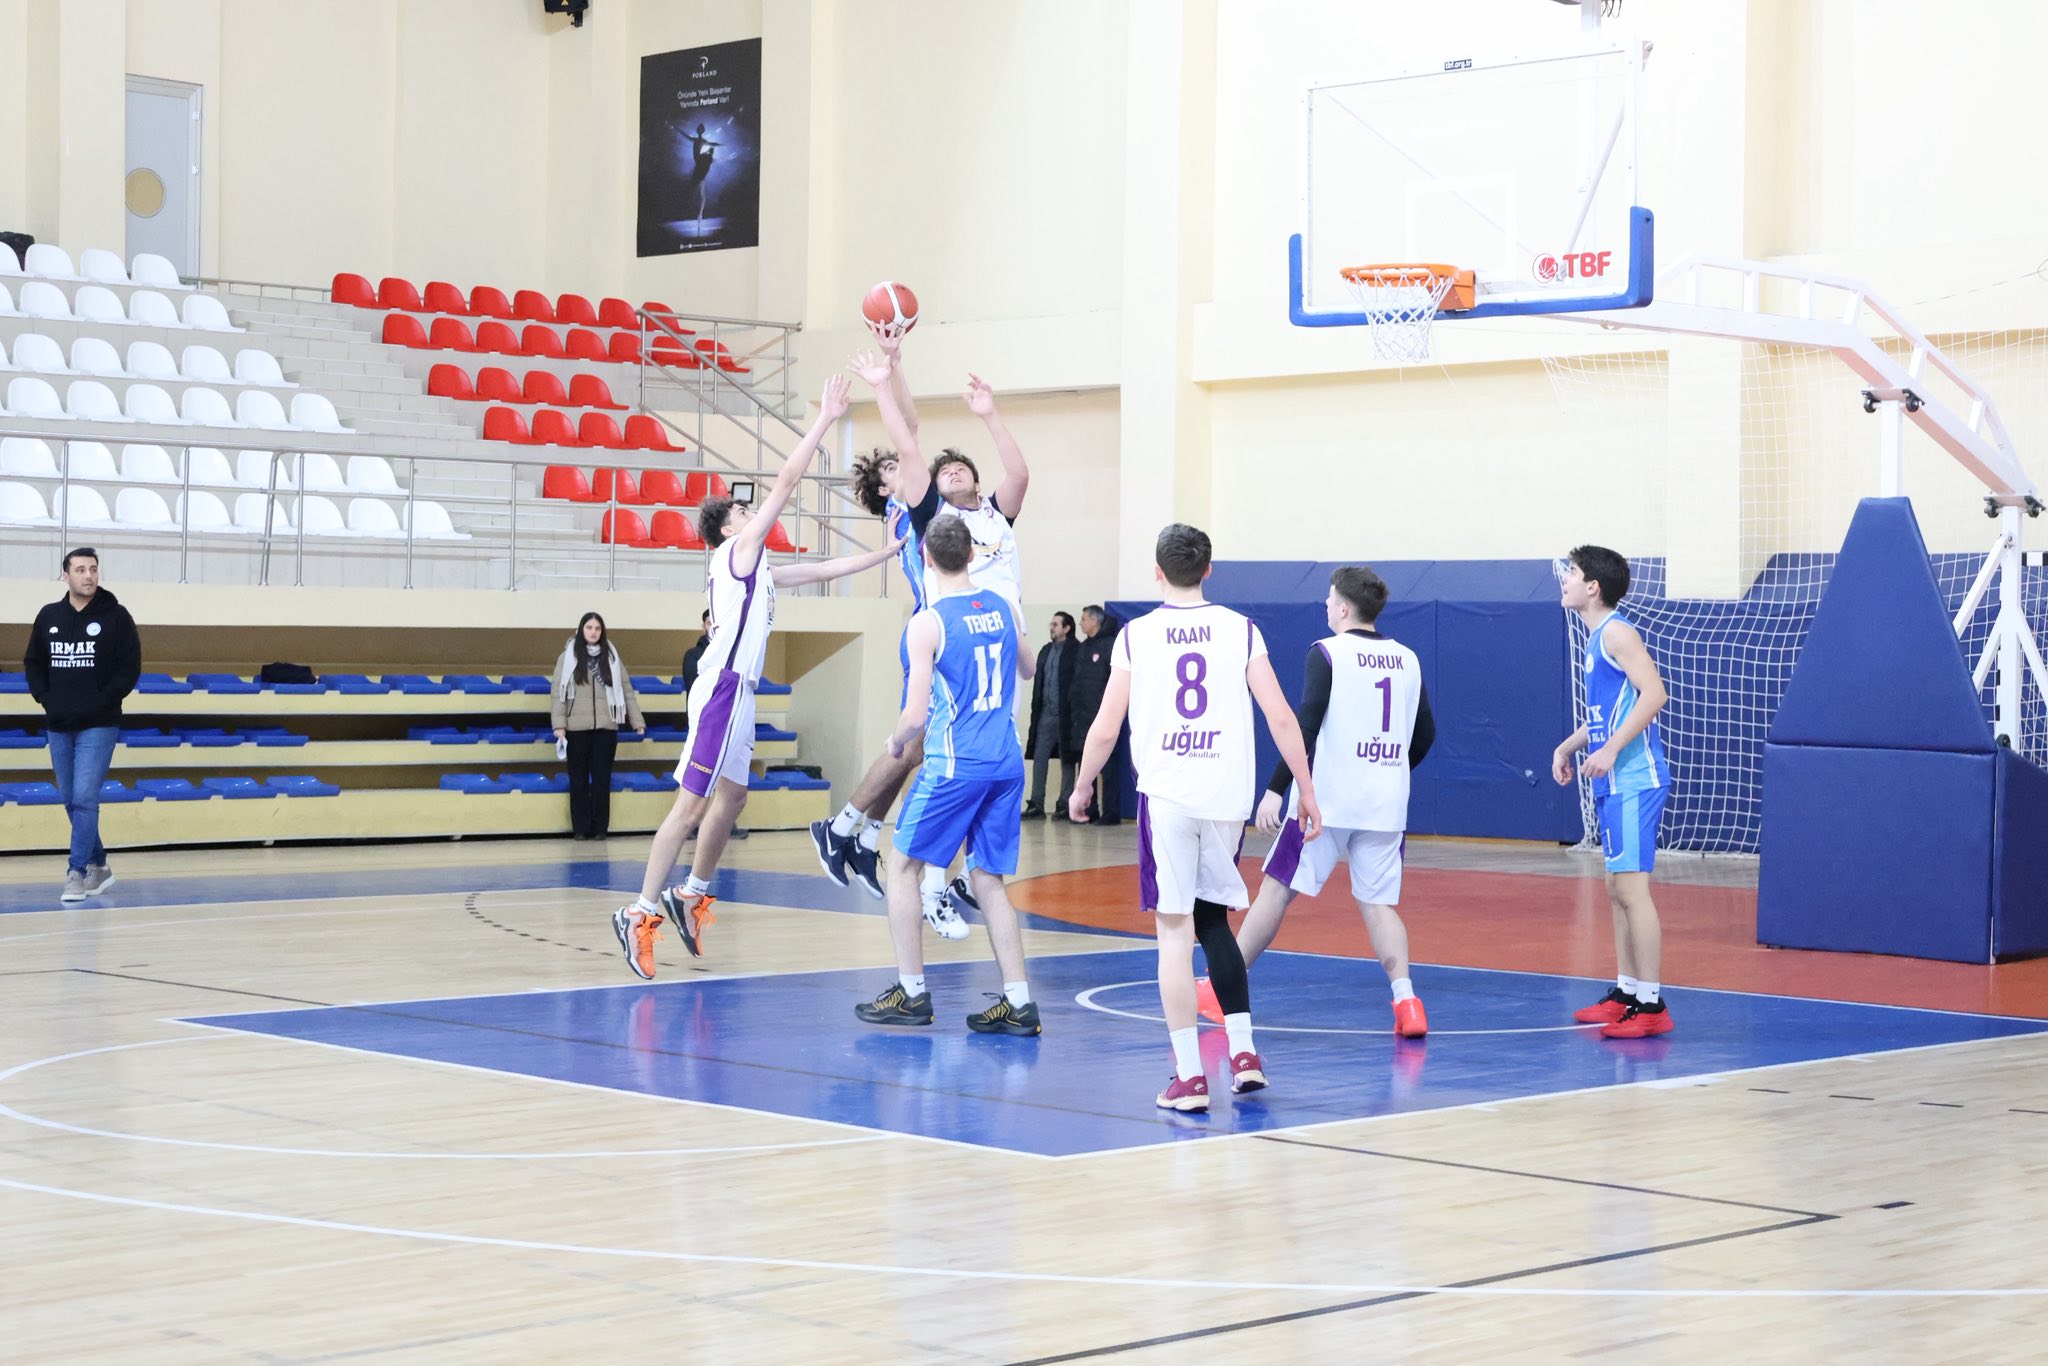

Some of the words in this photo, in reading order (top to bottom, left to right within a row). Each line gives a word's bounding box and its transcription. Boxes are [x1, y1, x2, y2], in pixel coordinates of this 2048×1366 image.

[1563, 251, 1612, 278] TBF
[963, 610, 1005, 635] TEVER
[1166, 625, 1211, 644] KAAN
[50, 641, 96, 654] IRMAK
[1357, 653, 1404, 670] DORUK
[1175, 652, 1208, 719] 8
[1375, 677, 1392, 732] 1
[1161, 724, 1222, 756] uğur
[1356, 736, 1402, 762] uğur
